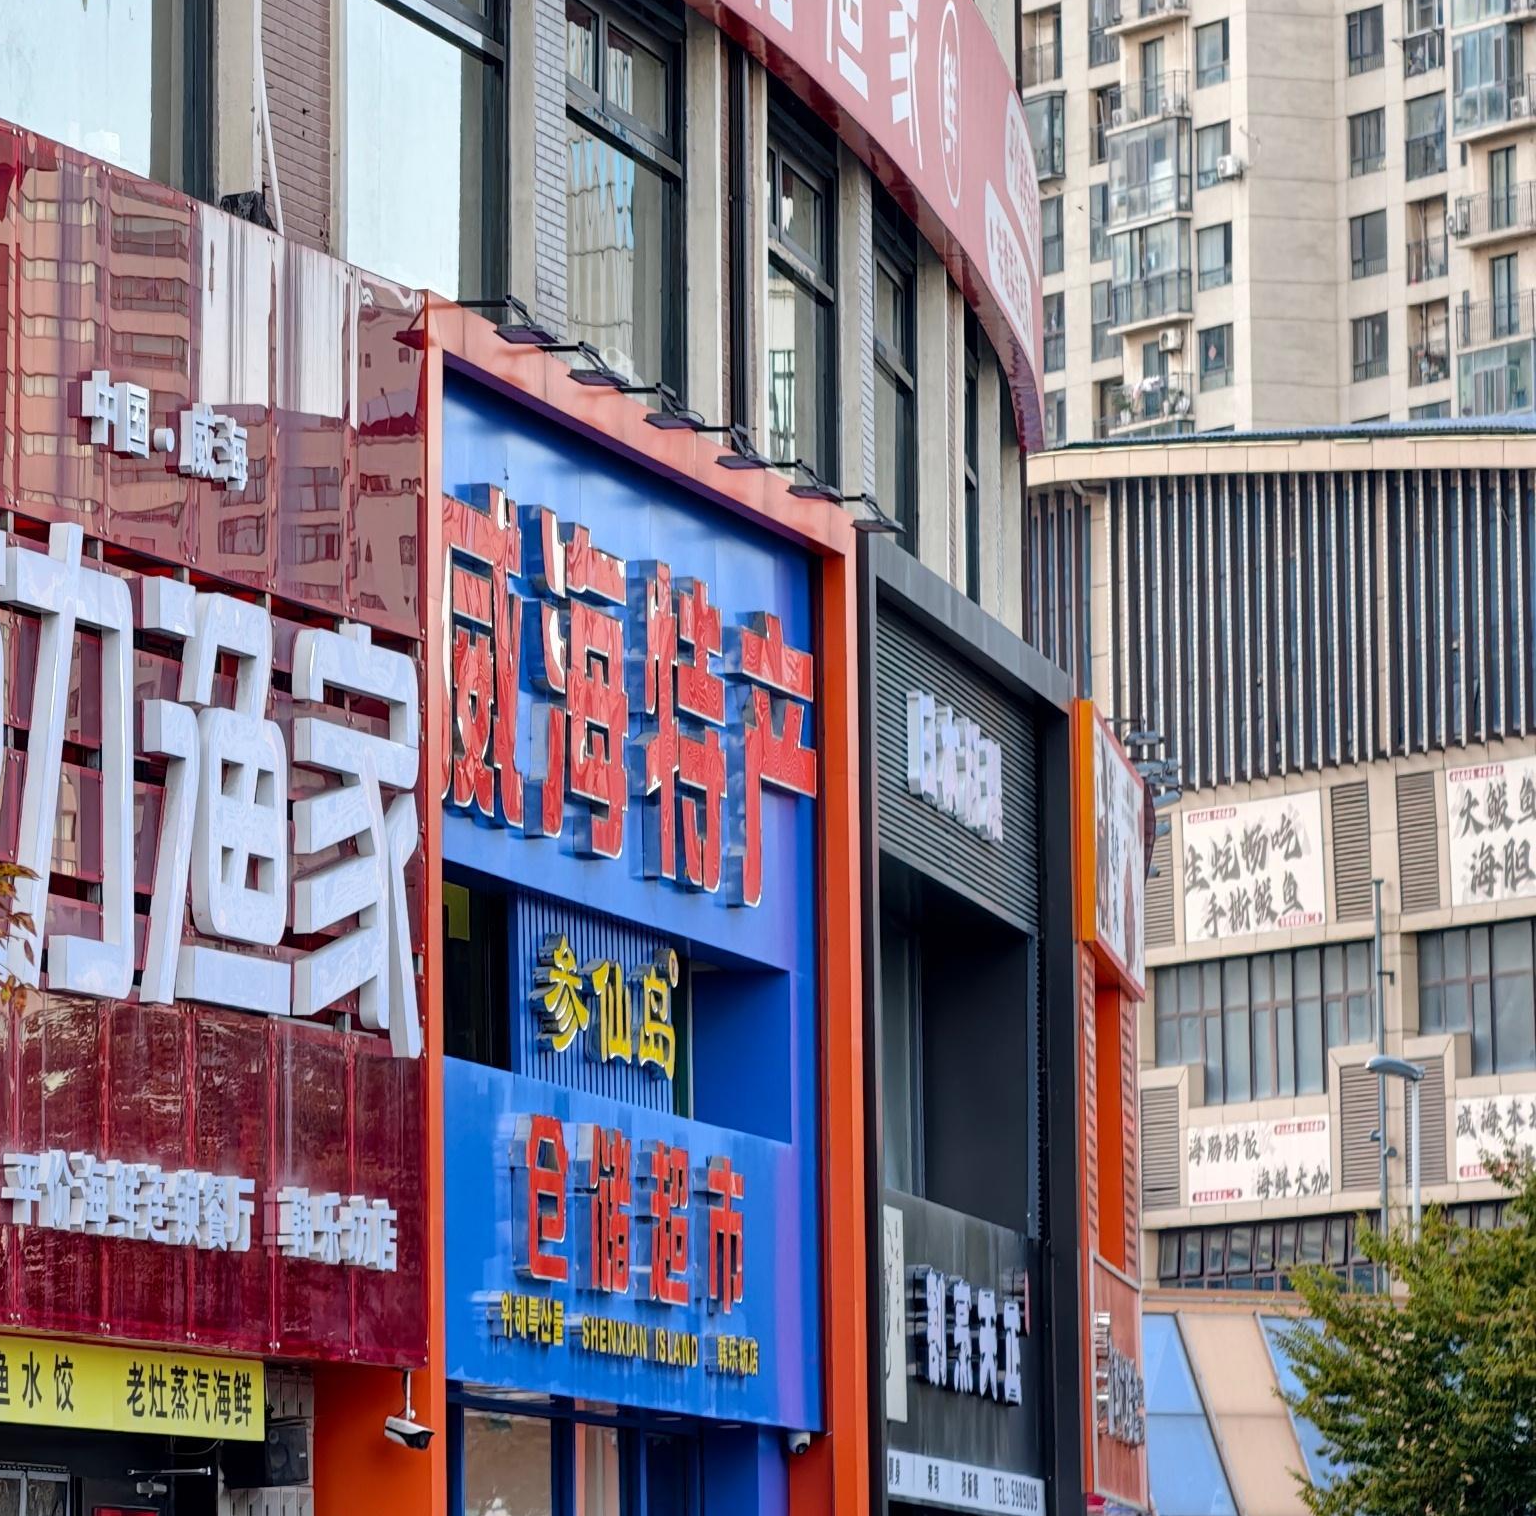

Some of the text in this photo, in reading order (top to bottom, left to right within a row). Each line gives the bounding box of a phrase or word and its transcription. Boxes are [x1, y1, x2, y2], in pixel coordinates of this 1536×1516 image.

[442, 484, 818, 909] 威海特产
[1184, 812, 1303, 896] 生蚝畅吃
[542, 932, 676, 1081] 参仙岛
[1, 1148, 256, 1253] 平价海鲜连锁餐厅
[526, 1114, 745, 1315] 仓储超市
[500, 1291, 564, 1347] 위해특산물
[581, 1315, 699, 1368] SHENXIAN ISLAND
[125, 1360, 255, 1430] 老灶蒸汽海鲜
